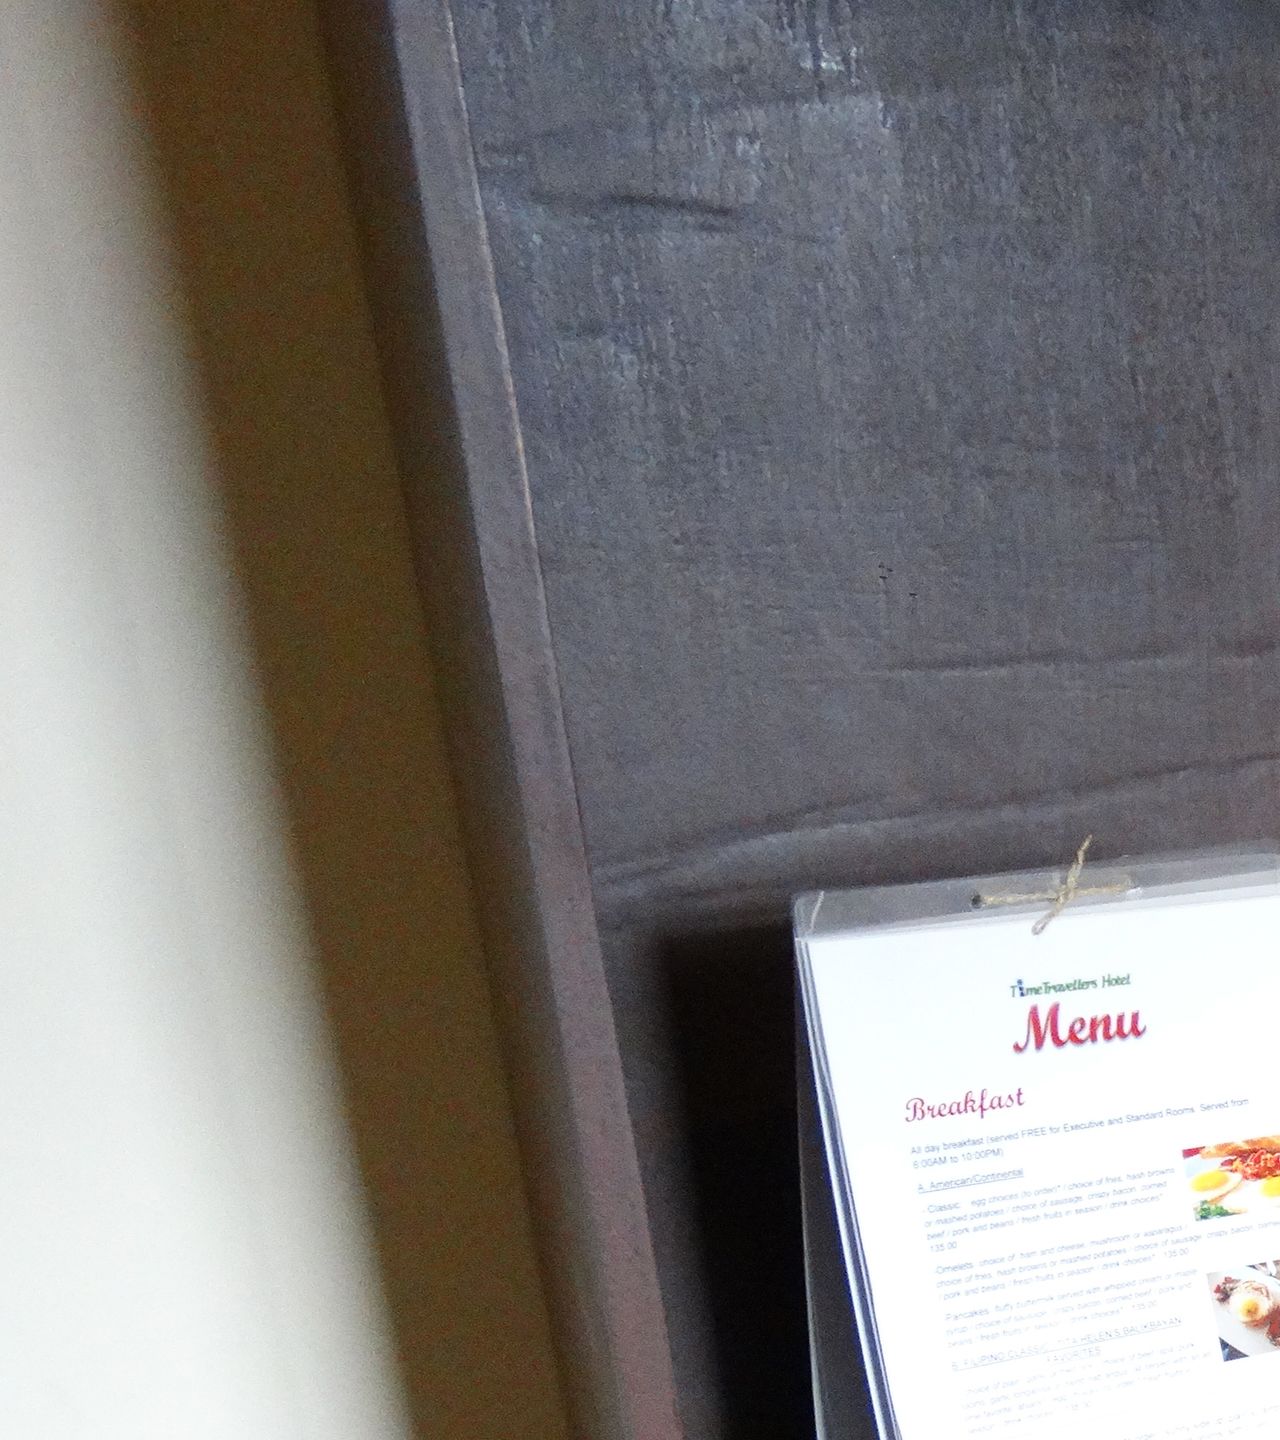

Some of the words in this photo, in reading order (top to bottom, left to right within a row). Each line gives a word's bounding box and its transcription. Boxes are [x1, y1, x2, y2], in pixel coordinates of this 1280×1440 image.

[1102, 973, 1131, 989] Hotel
[1012, 1000, 1147, 1053] Menu
[905, 1087, 1026, 1123] Breakfast
[910, 1146, 922, 1155] All
[924, 1143, 940, 1154] day
[942, 1137, 984, 1150] breakfast
[1021, 1127, 1047, 1138] FREE
[1049, 1125, 1061, 1134] for
[1063, 1119, 1105, 1132] Executive
[1107, 1116, 1123, 1125] and
[1126, 1110, 1163, 1122] Standard
[1200, 1100, 1229, 1111] Served
[1231, 1097, 1249, 1107] from
[950, 1155, 959, 1163] to
